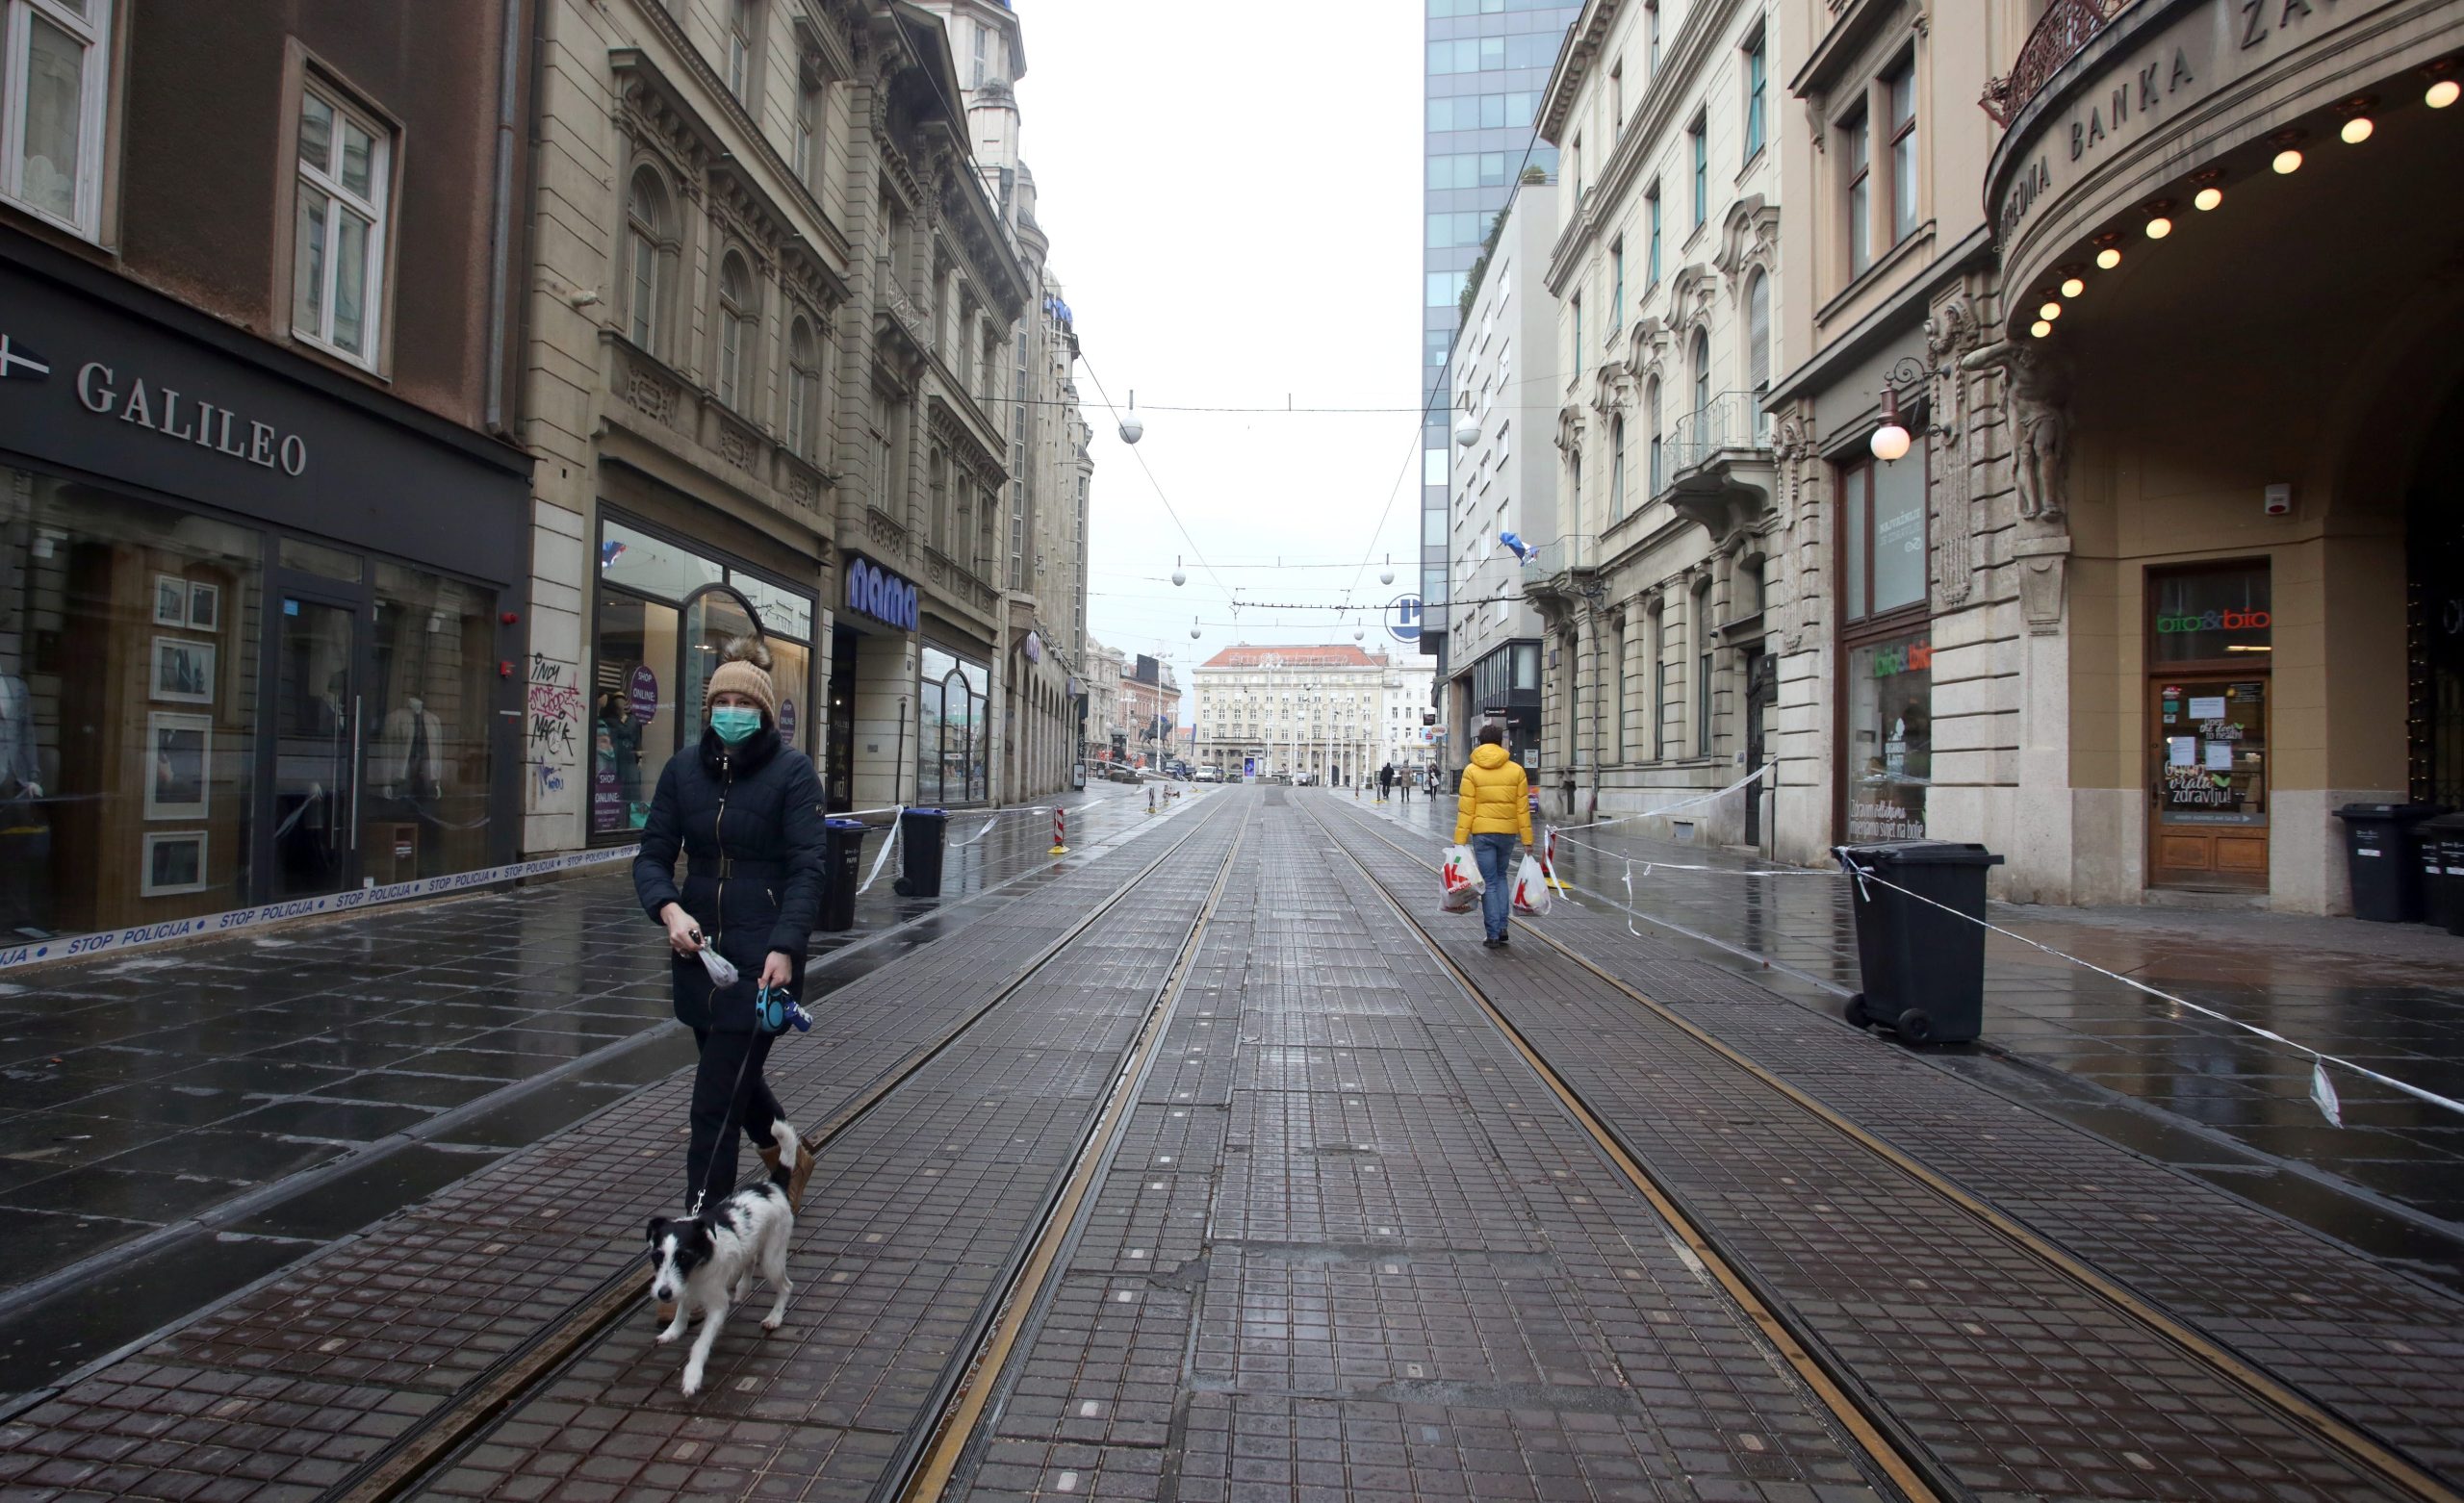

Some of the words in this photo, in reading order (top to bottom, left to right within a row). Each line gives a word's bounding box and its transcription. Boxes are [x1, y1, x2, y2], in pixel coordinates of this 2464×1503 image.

[2070, 46, 2194, 162] BANKA
[2241, 0, 2337, 50] ZA
[77, 362, 307, 476] GALILEO
[849, 557, 917, 632] nama
[2156, 606, 2272, 633] bio&bio
[638, 671, 653, 682] SHOP
[1210, 702, 1266, 711] GRADSKA
[2206, 731, 2215, 740] to
[600, 774, 615, 784] SHOP
[2169, 774, 2214, 789] vrata
[2172, 787, 2232, 806] zdravlju!
[1897, 823, 1906, 839] na
[68, 933, 115, 955] STOP
[122, 921, 191, 946] POLICIJA
[219, 910, 255, 929] STOP
[261, 900, 313, 921] POLICIJA
[337, 892, 364, 907] STOP
[369, 884, 411, 902] POLICIJA
[428, 878, 451, 892] STOP
[455, 870, 489, 886] POLICIJA
[504, 866, 523, 879] STOP
[526, 859, 555, 874] POLICIJA
[567, 853, 583, 866] STOP
[585, 848, 610, 864] POLICIJA
